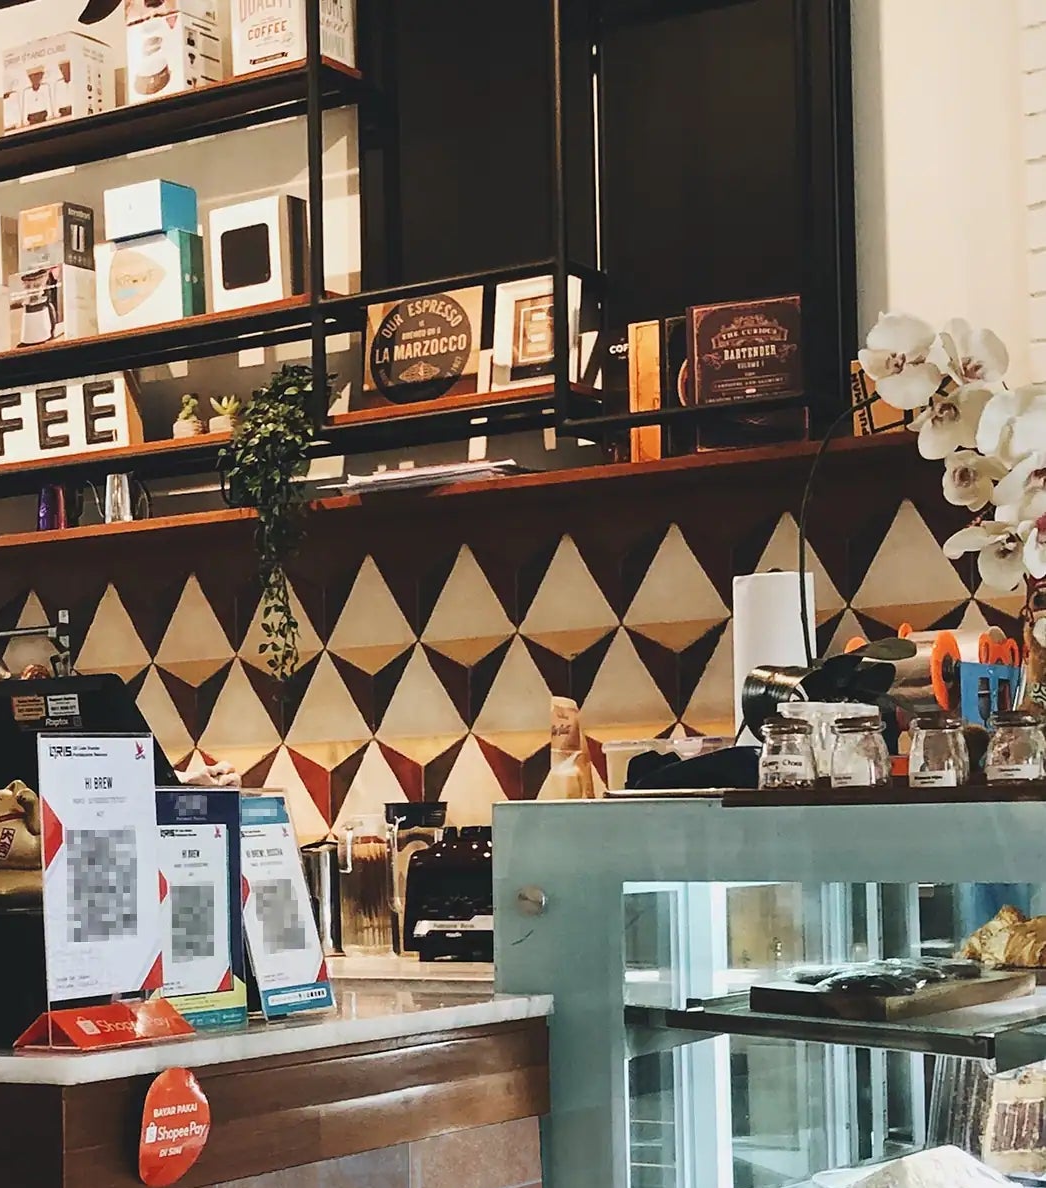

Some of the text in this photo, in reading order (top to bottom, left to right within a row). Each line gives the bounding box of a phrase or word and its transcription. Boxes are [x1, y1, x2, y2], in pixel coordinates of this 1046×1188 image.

[248, 20, 288, 40] COFFEE
[382, 300, 463, 338] OUR ESPRESSO
[375, 334, 467, 364] LA MARZOCCO
[723, 344, 777, 361] BARTENDER
[94, 777, 113, 790] BREW
[154, 1102, 198, 1118] BAYAR PAKAI
